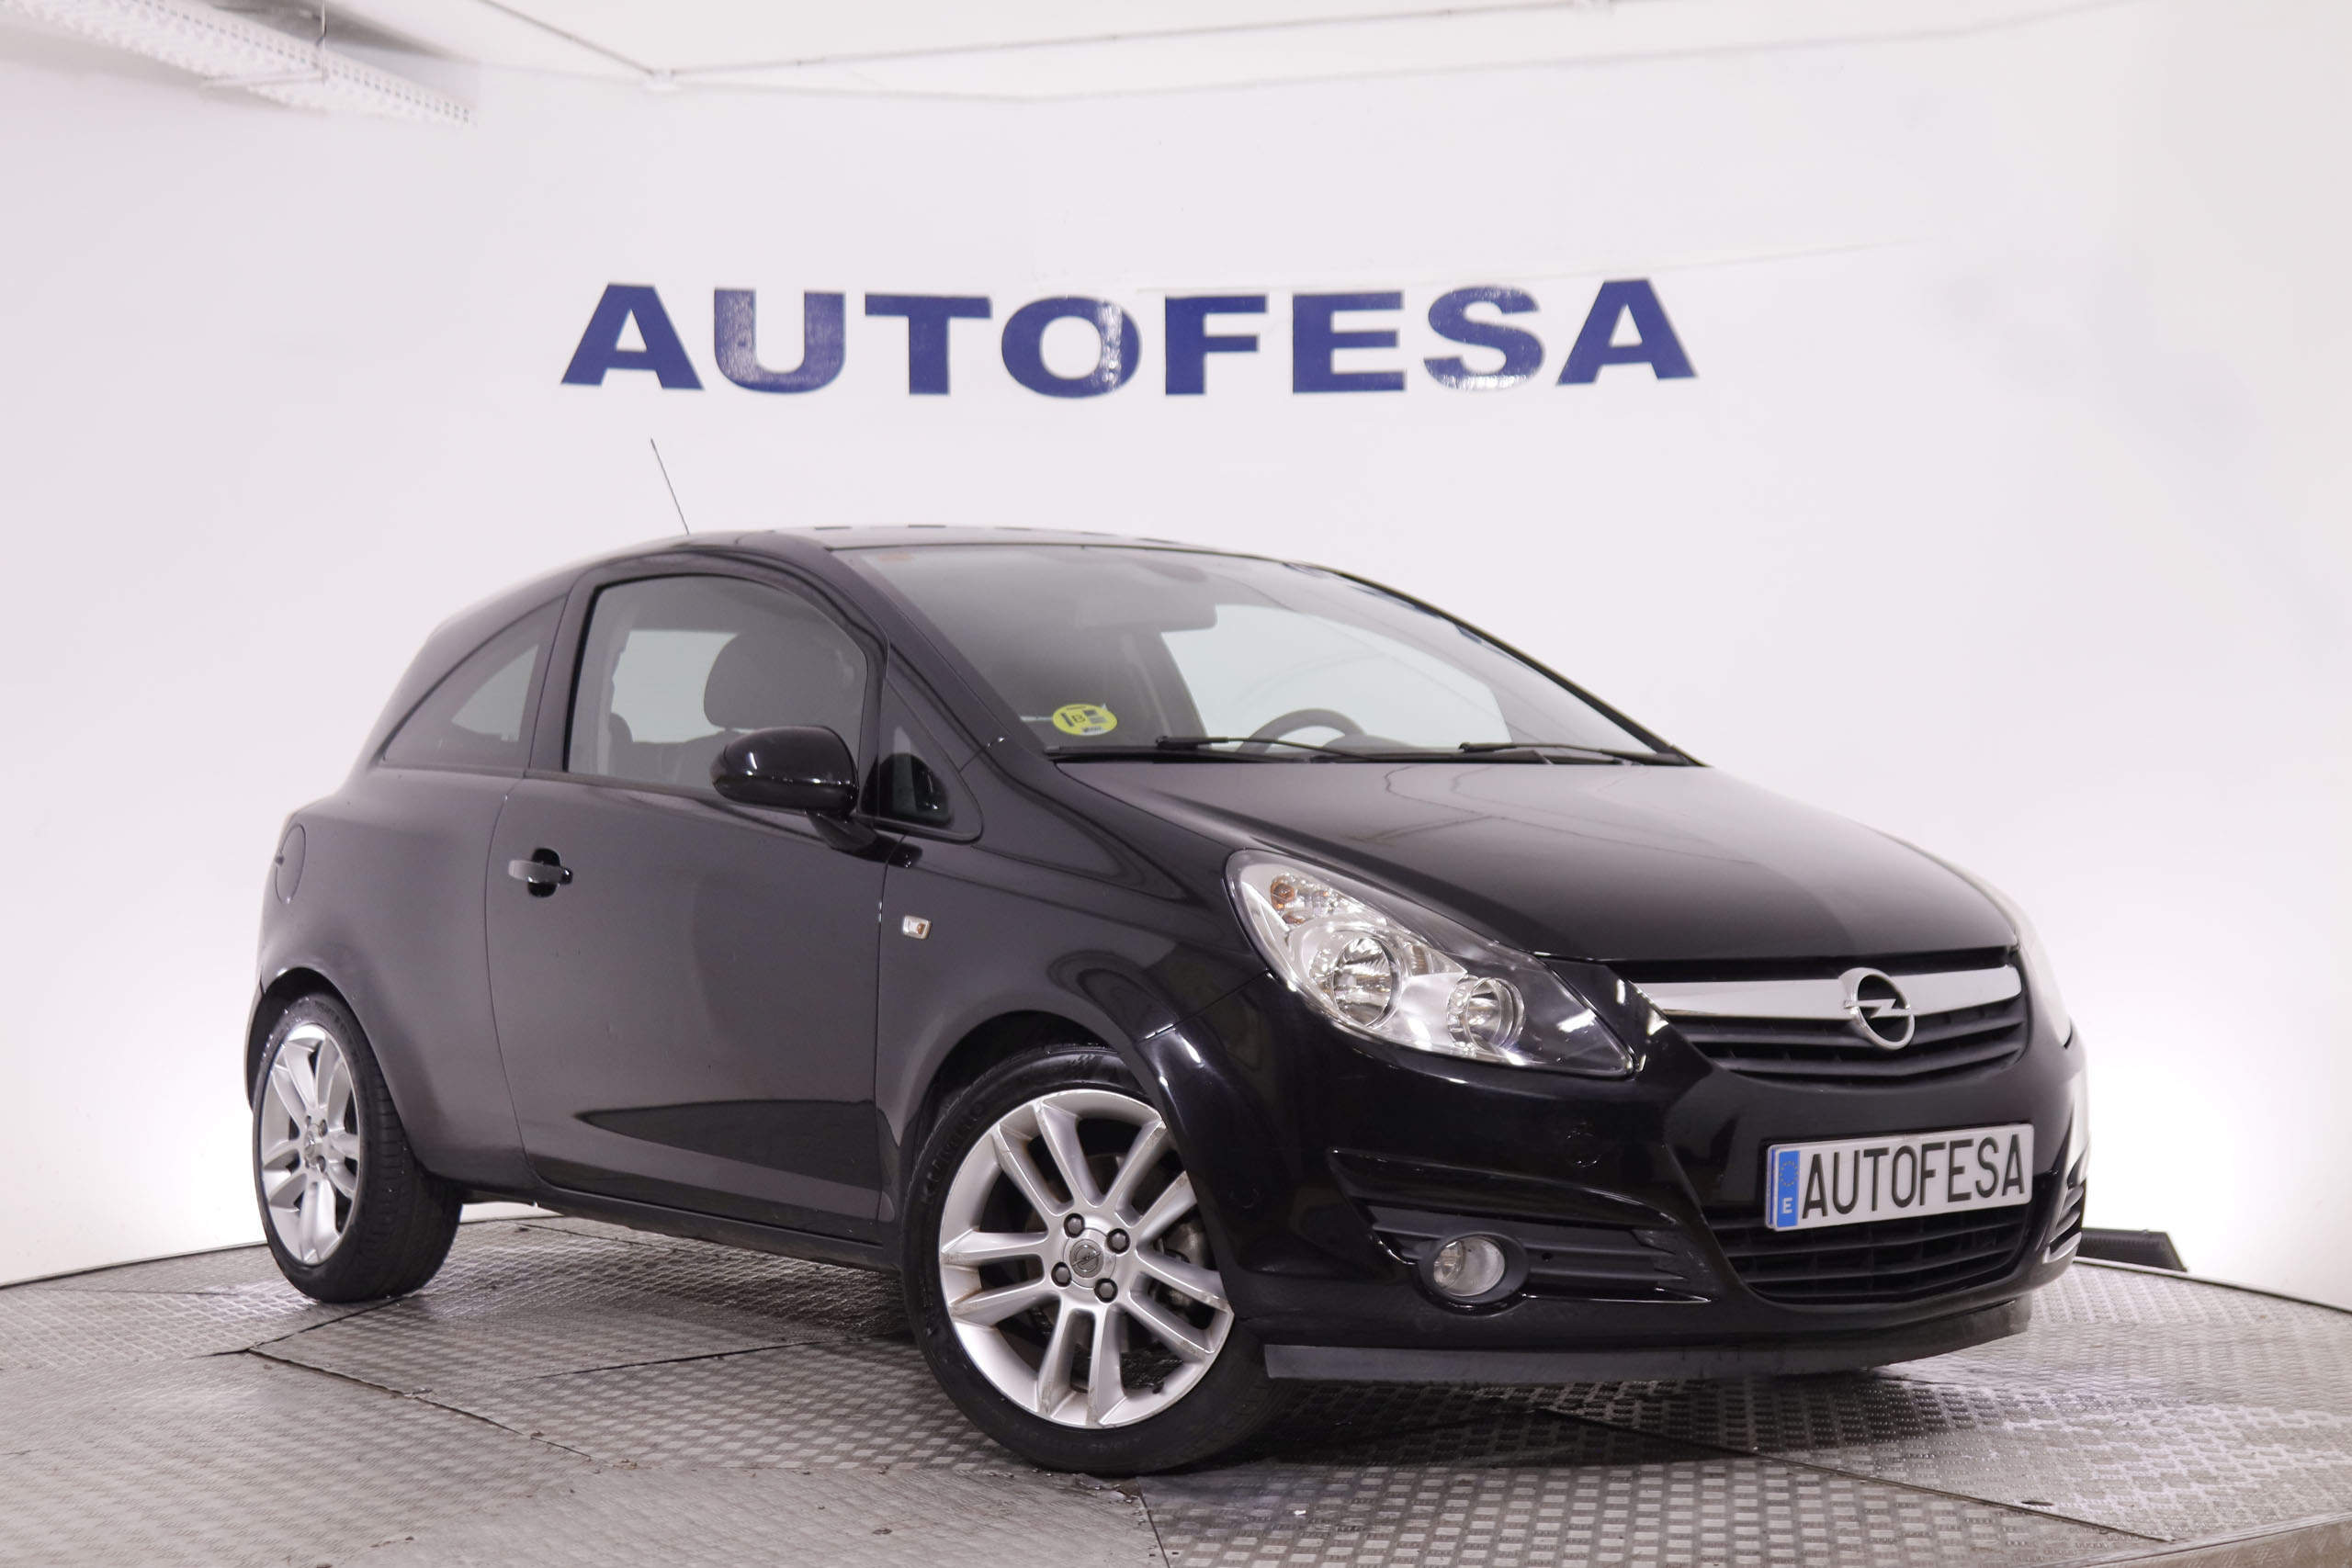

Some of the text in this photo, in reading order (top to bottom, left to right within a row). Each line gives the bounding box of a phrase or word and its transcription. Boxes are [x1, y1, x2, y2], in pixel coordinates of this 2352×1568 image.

[561, 277, 1696, 398] AUTOFESA
[1781, 1197, 1793, 1214] E
[1802, 1134, 2026, 1219] AUTOFESA
